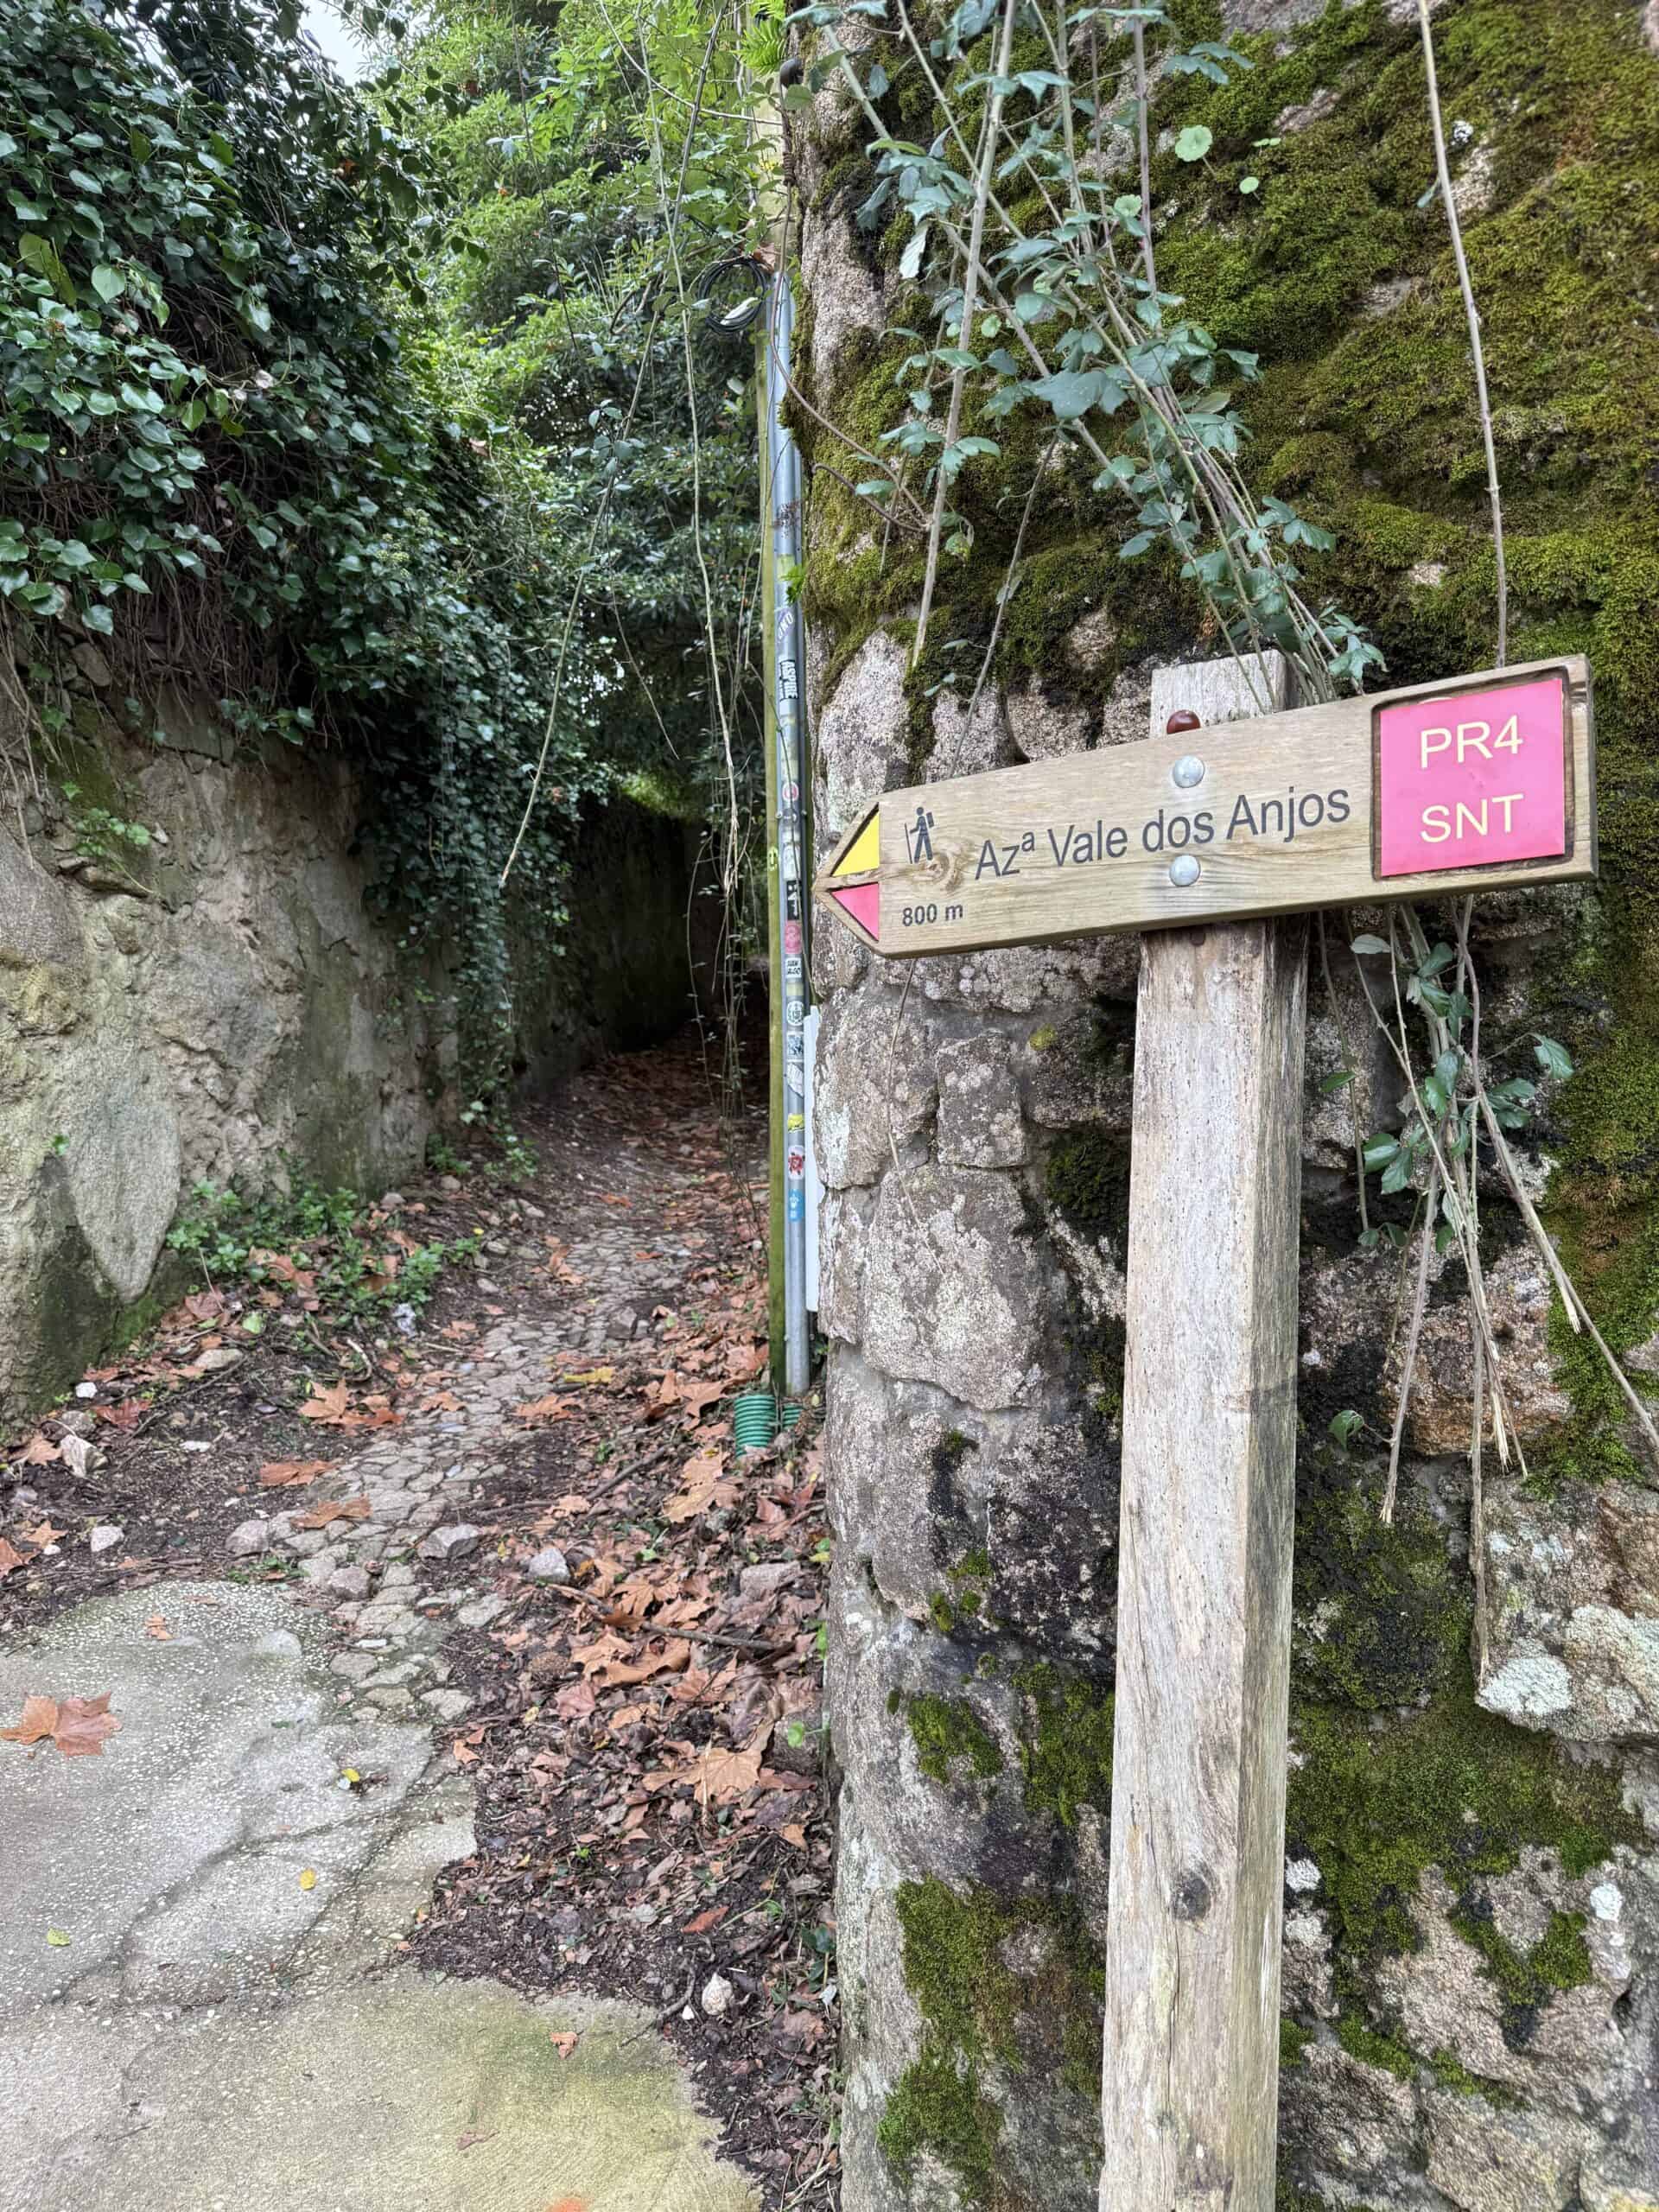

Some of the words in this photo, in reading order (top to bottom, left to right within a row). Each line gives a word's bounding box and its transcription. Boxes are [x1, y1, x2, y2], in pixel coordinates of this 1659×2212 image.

[781, 661, 798, 698] ASPIRE
[1420, 715, 1522, 769] PR4
[1047, 820, 1128, 868] Vale
[1142, 806, 1214, 851] dos
[1226, 786, 1351, 844] Anjos
[1420, 795, 1524, 844] SNT
[902, 905, 939, 927] 800
[944, 905, 964, 920] m
